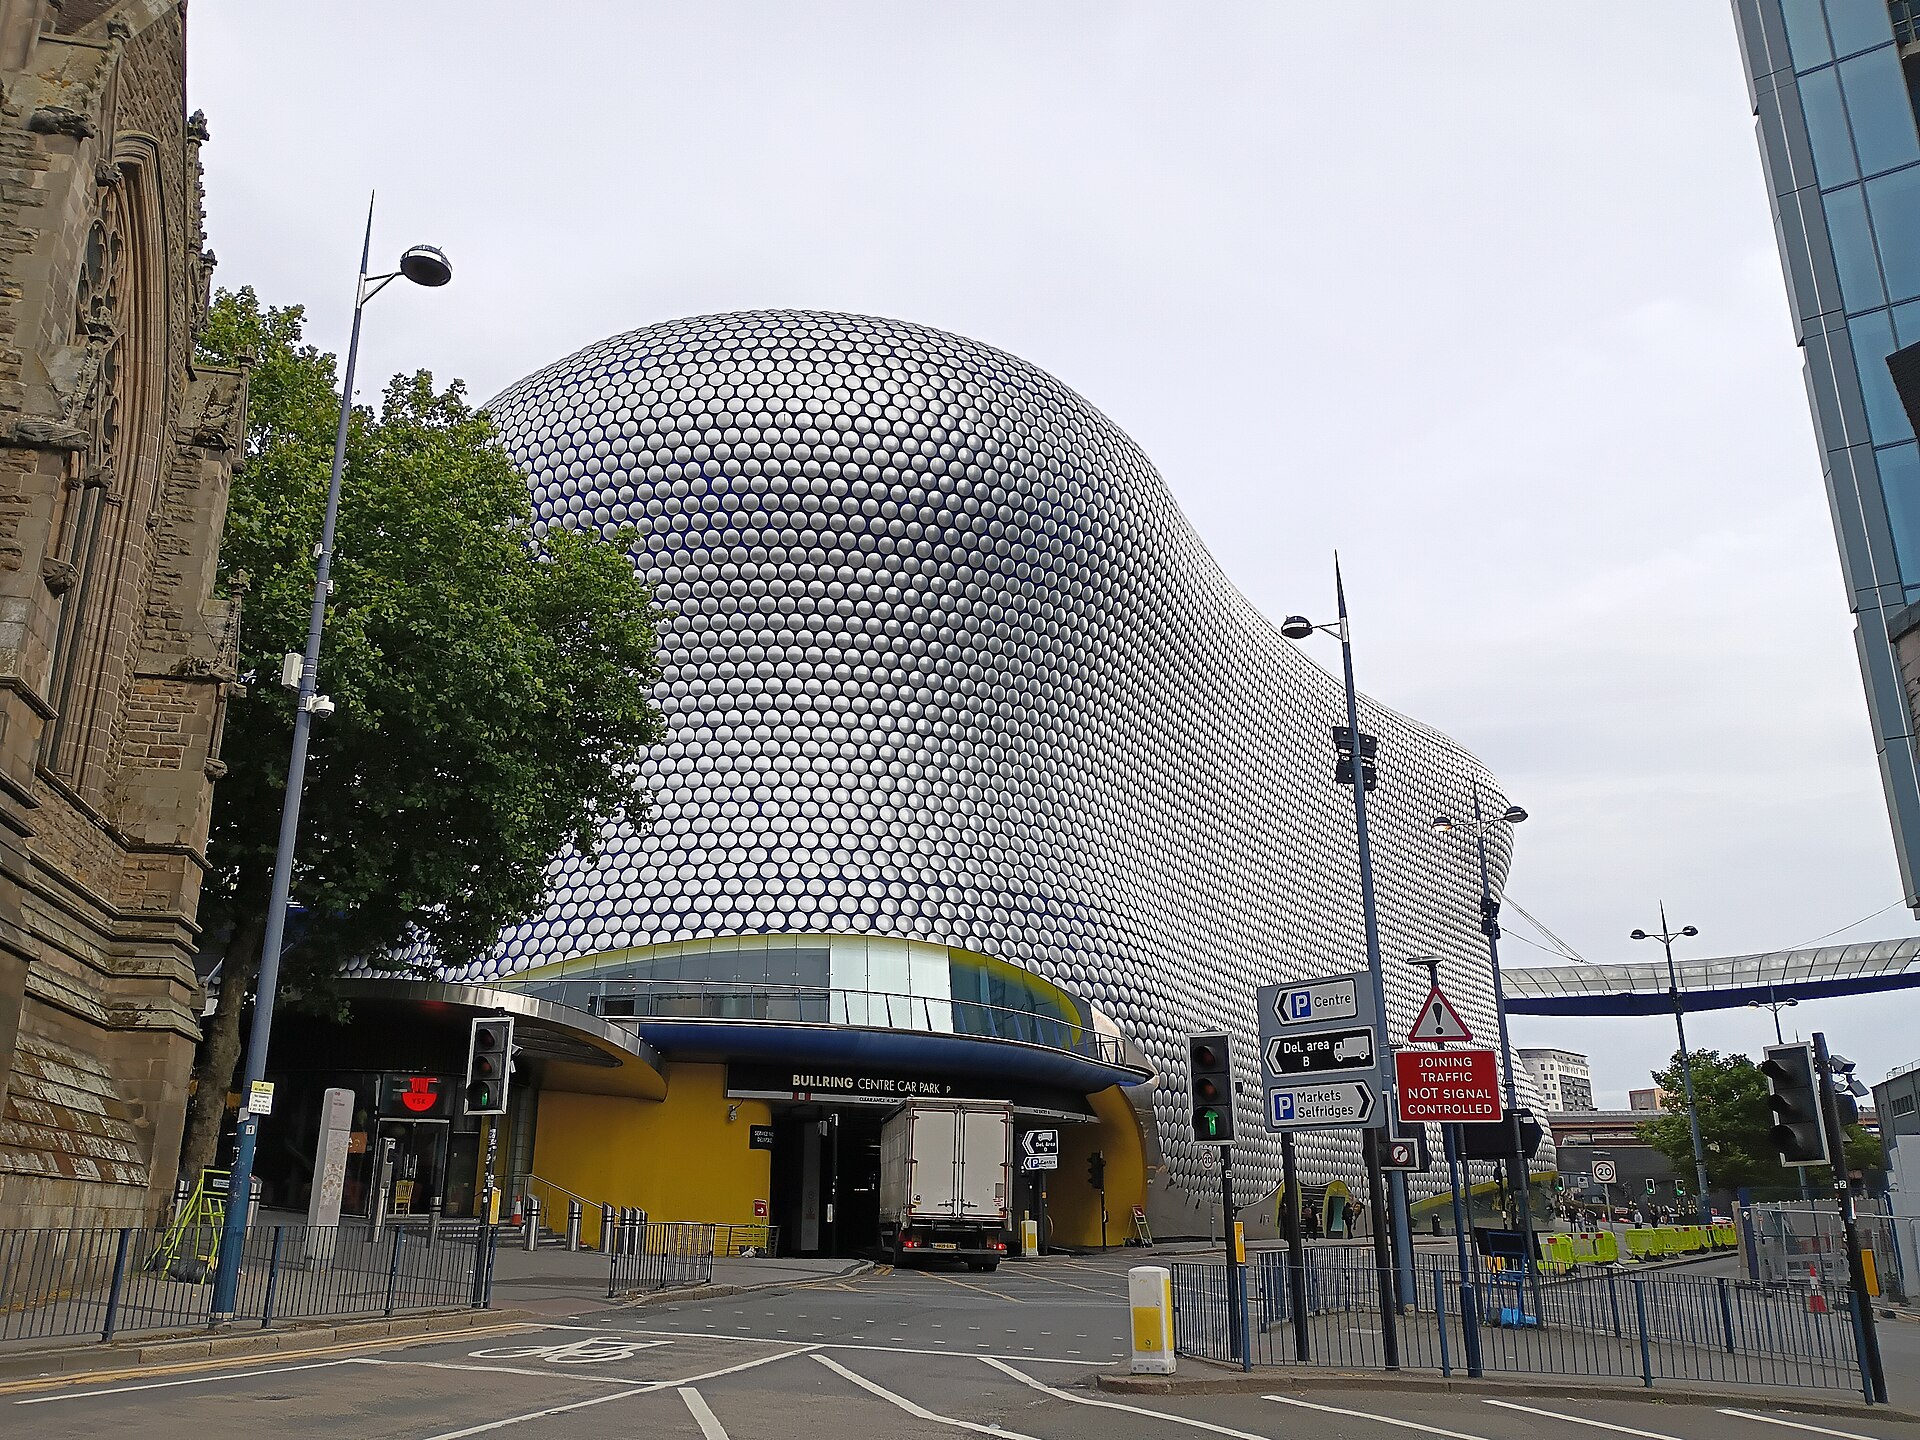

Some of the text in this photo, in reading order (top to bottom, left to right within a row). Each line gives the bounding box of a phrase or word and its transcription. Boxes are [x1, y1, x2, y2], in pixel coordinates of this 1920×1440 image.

[1295, 993, 1351, 1016] P Centre
[1283, 1040, 1330, 1053] Del. area
[1302, 1056, 1310, 1067] B
[1418, 1056, 1473, 1068] JOINING
[1420, 1071, 1473, 1082] TRAFFIC
[792, 1074, 854, 1089] BULLRING
[857, 1077, 895, 1091] CENTRE
[897, 1080, 917, 1093] CAR
[919, 1082, 940, 1094] PARK
[1407, 1087, 1492, 1099] NOT SIGNAL
[1278, 1090, 1341, 1118] P Markets
[1407, 1103, 1493, 1115] CONTROLLED
[1298, 1105, 1354, 1119] Selfridges
[1597, 1167, 1612, 1176] 20
